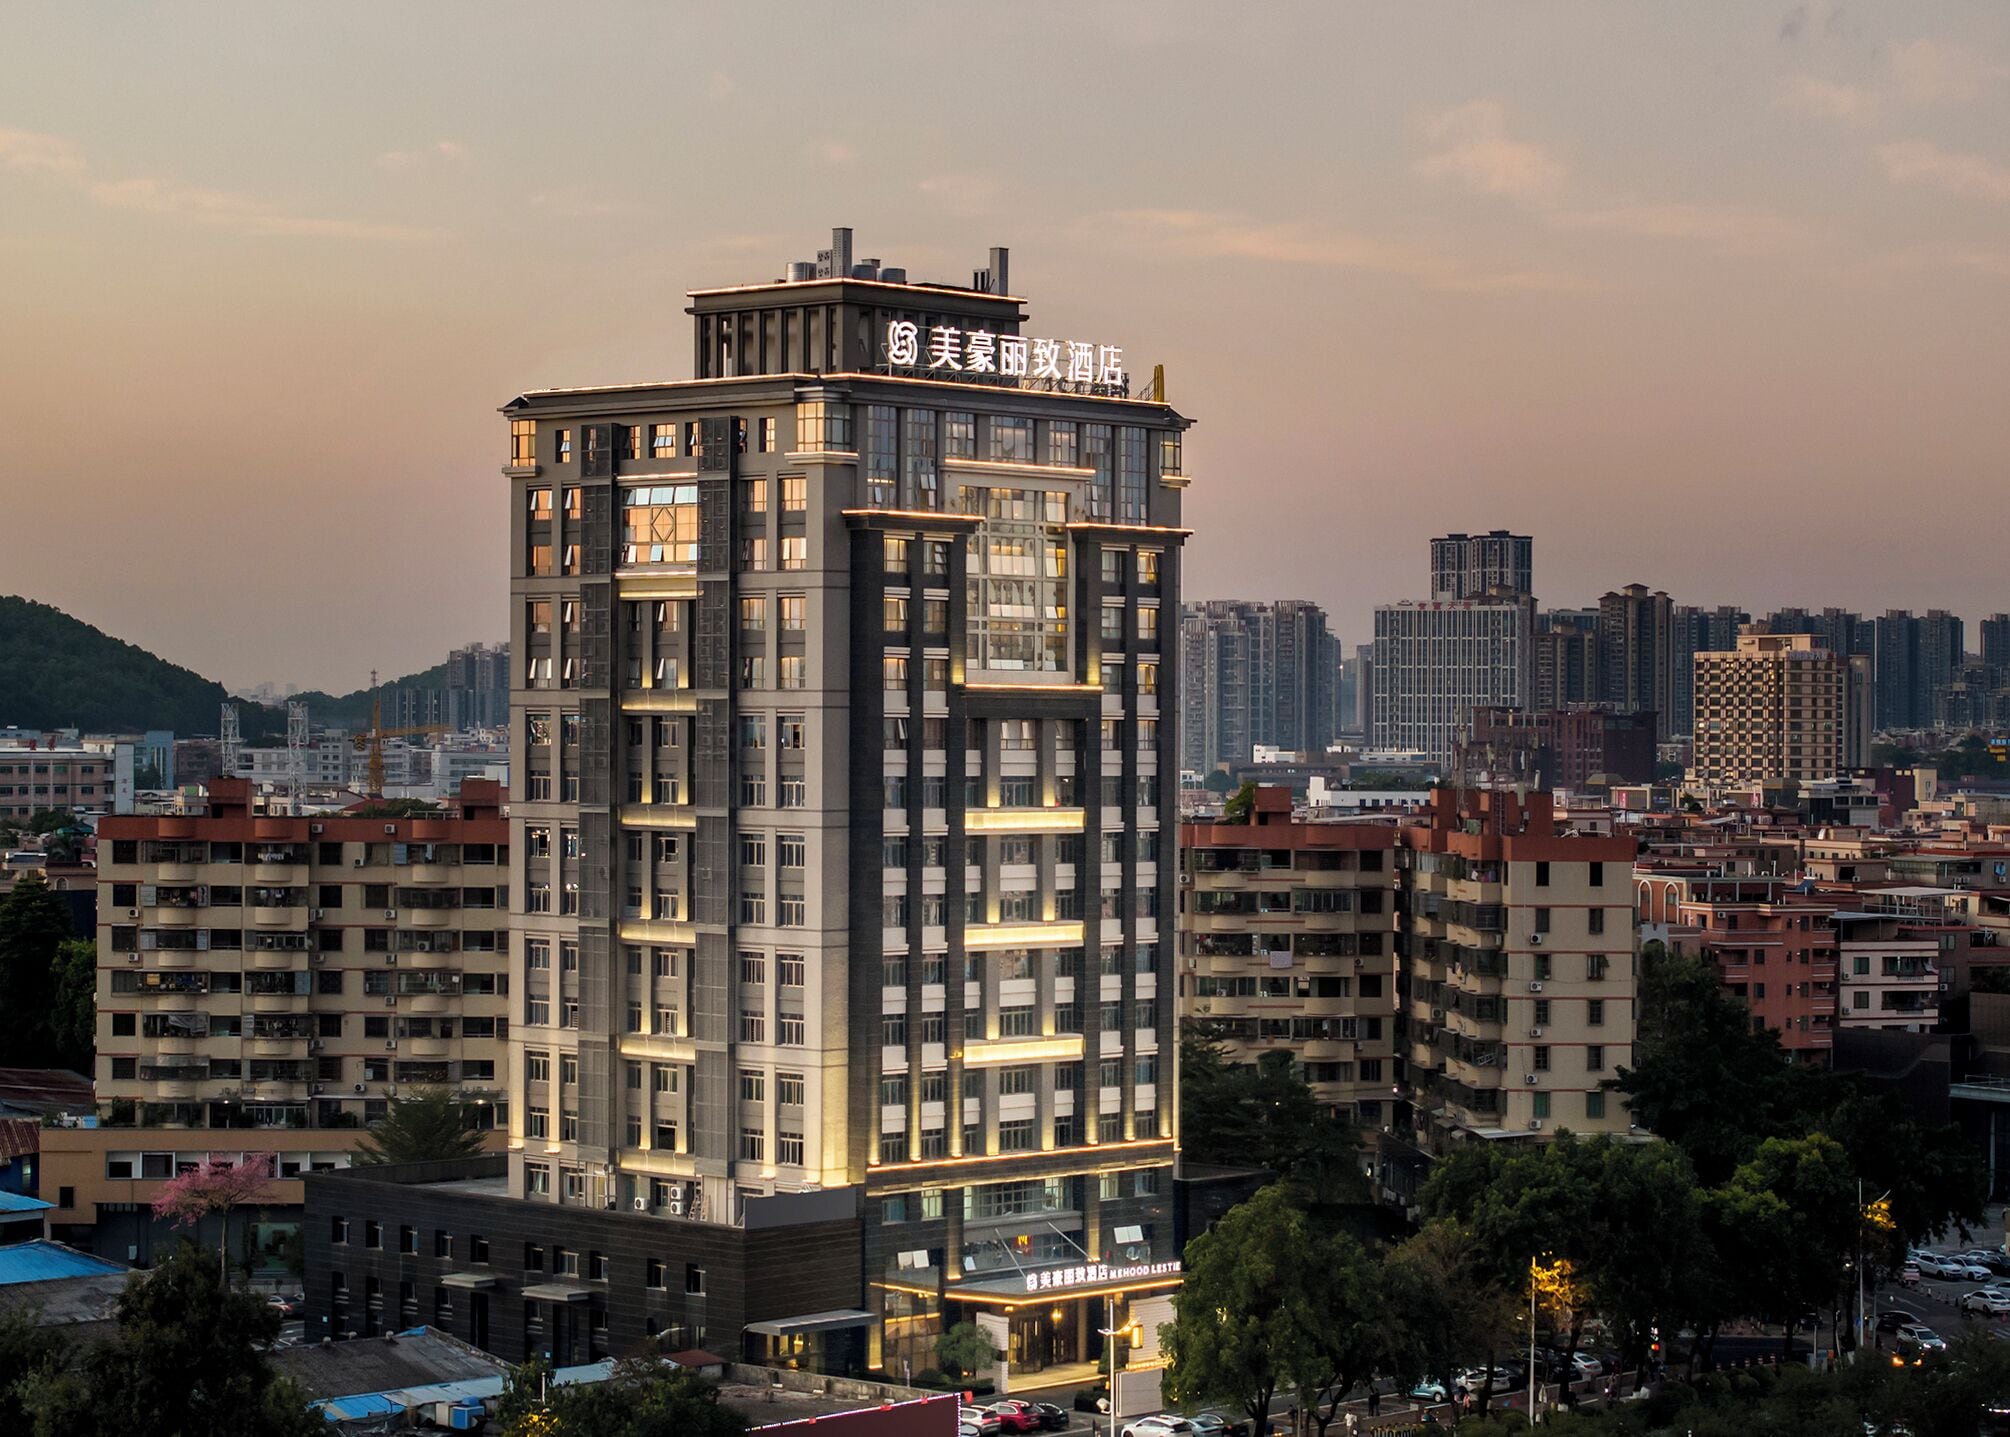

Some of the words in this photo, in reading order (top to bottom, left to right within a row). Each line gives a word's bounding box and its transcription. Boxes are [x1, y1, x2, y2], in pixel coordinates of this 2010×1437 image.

[930, 326, 1123, 385] 美豪丽致酒店
[1109, 1265, 1149, 1279] MEHOOD
[1151, 1261, 1181, 1274] LESTIE
